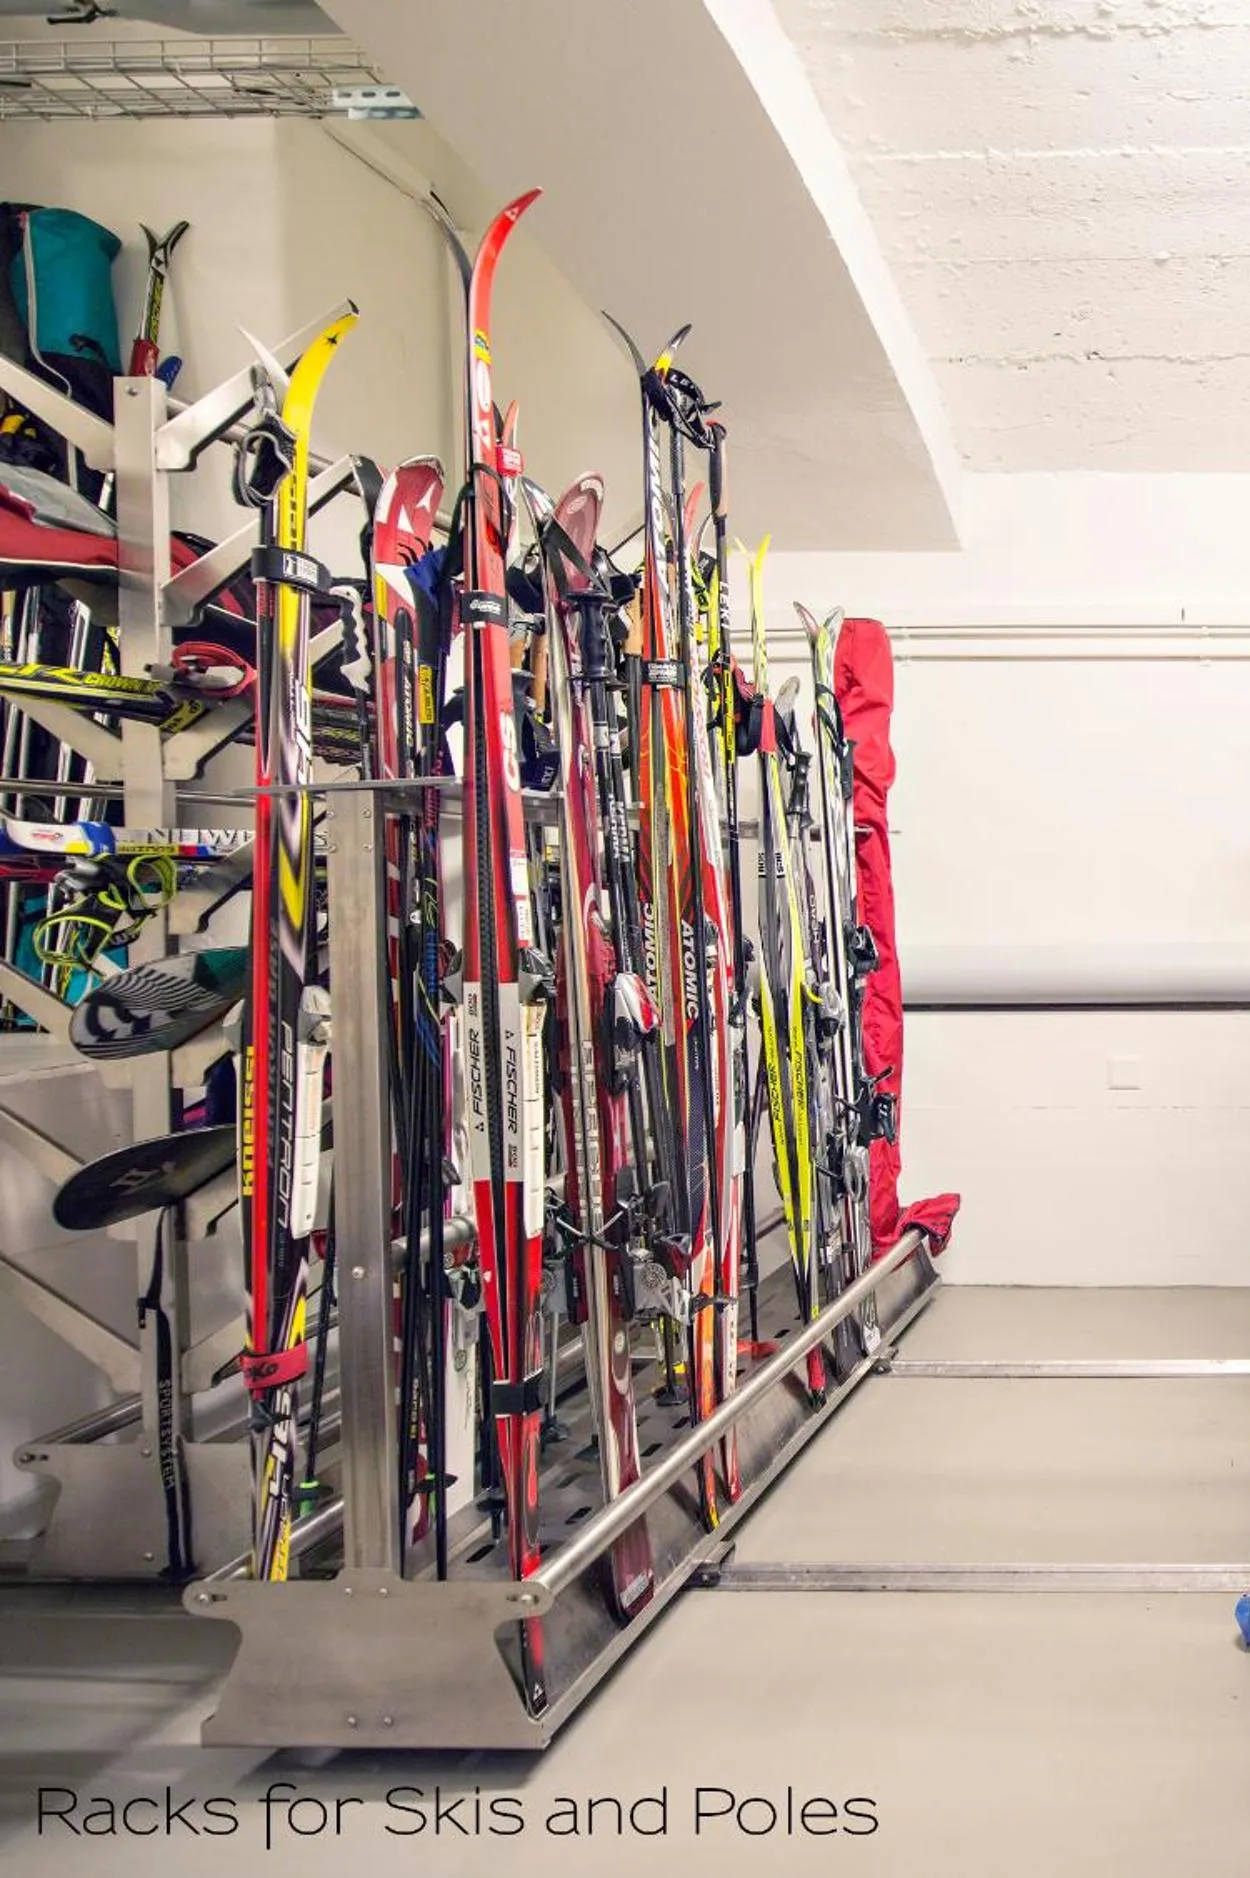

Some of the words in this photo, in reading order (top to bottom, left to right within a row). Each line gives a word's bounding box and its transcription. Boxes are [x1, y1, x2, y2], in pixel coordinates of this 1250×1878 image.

[641, 903, 658, 997] ATOMIC
[681, 920, 698, 1019] ATOMIC
[465, 1030, 484, 1116] FISCHER
[505, 1045, 518, 1135] FISCHER
[277, 1020, 293, 1228] PENTRON
